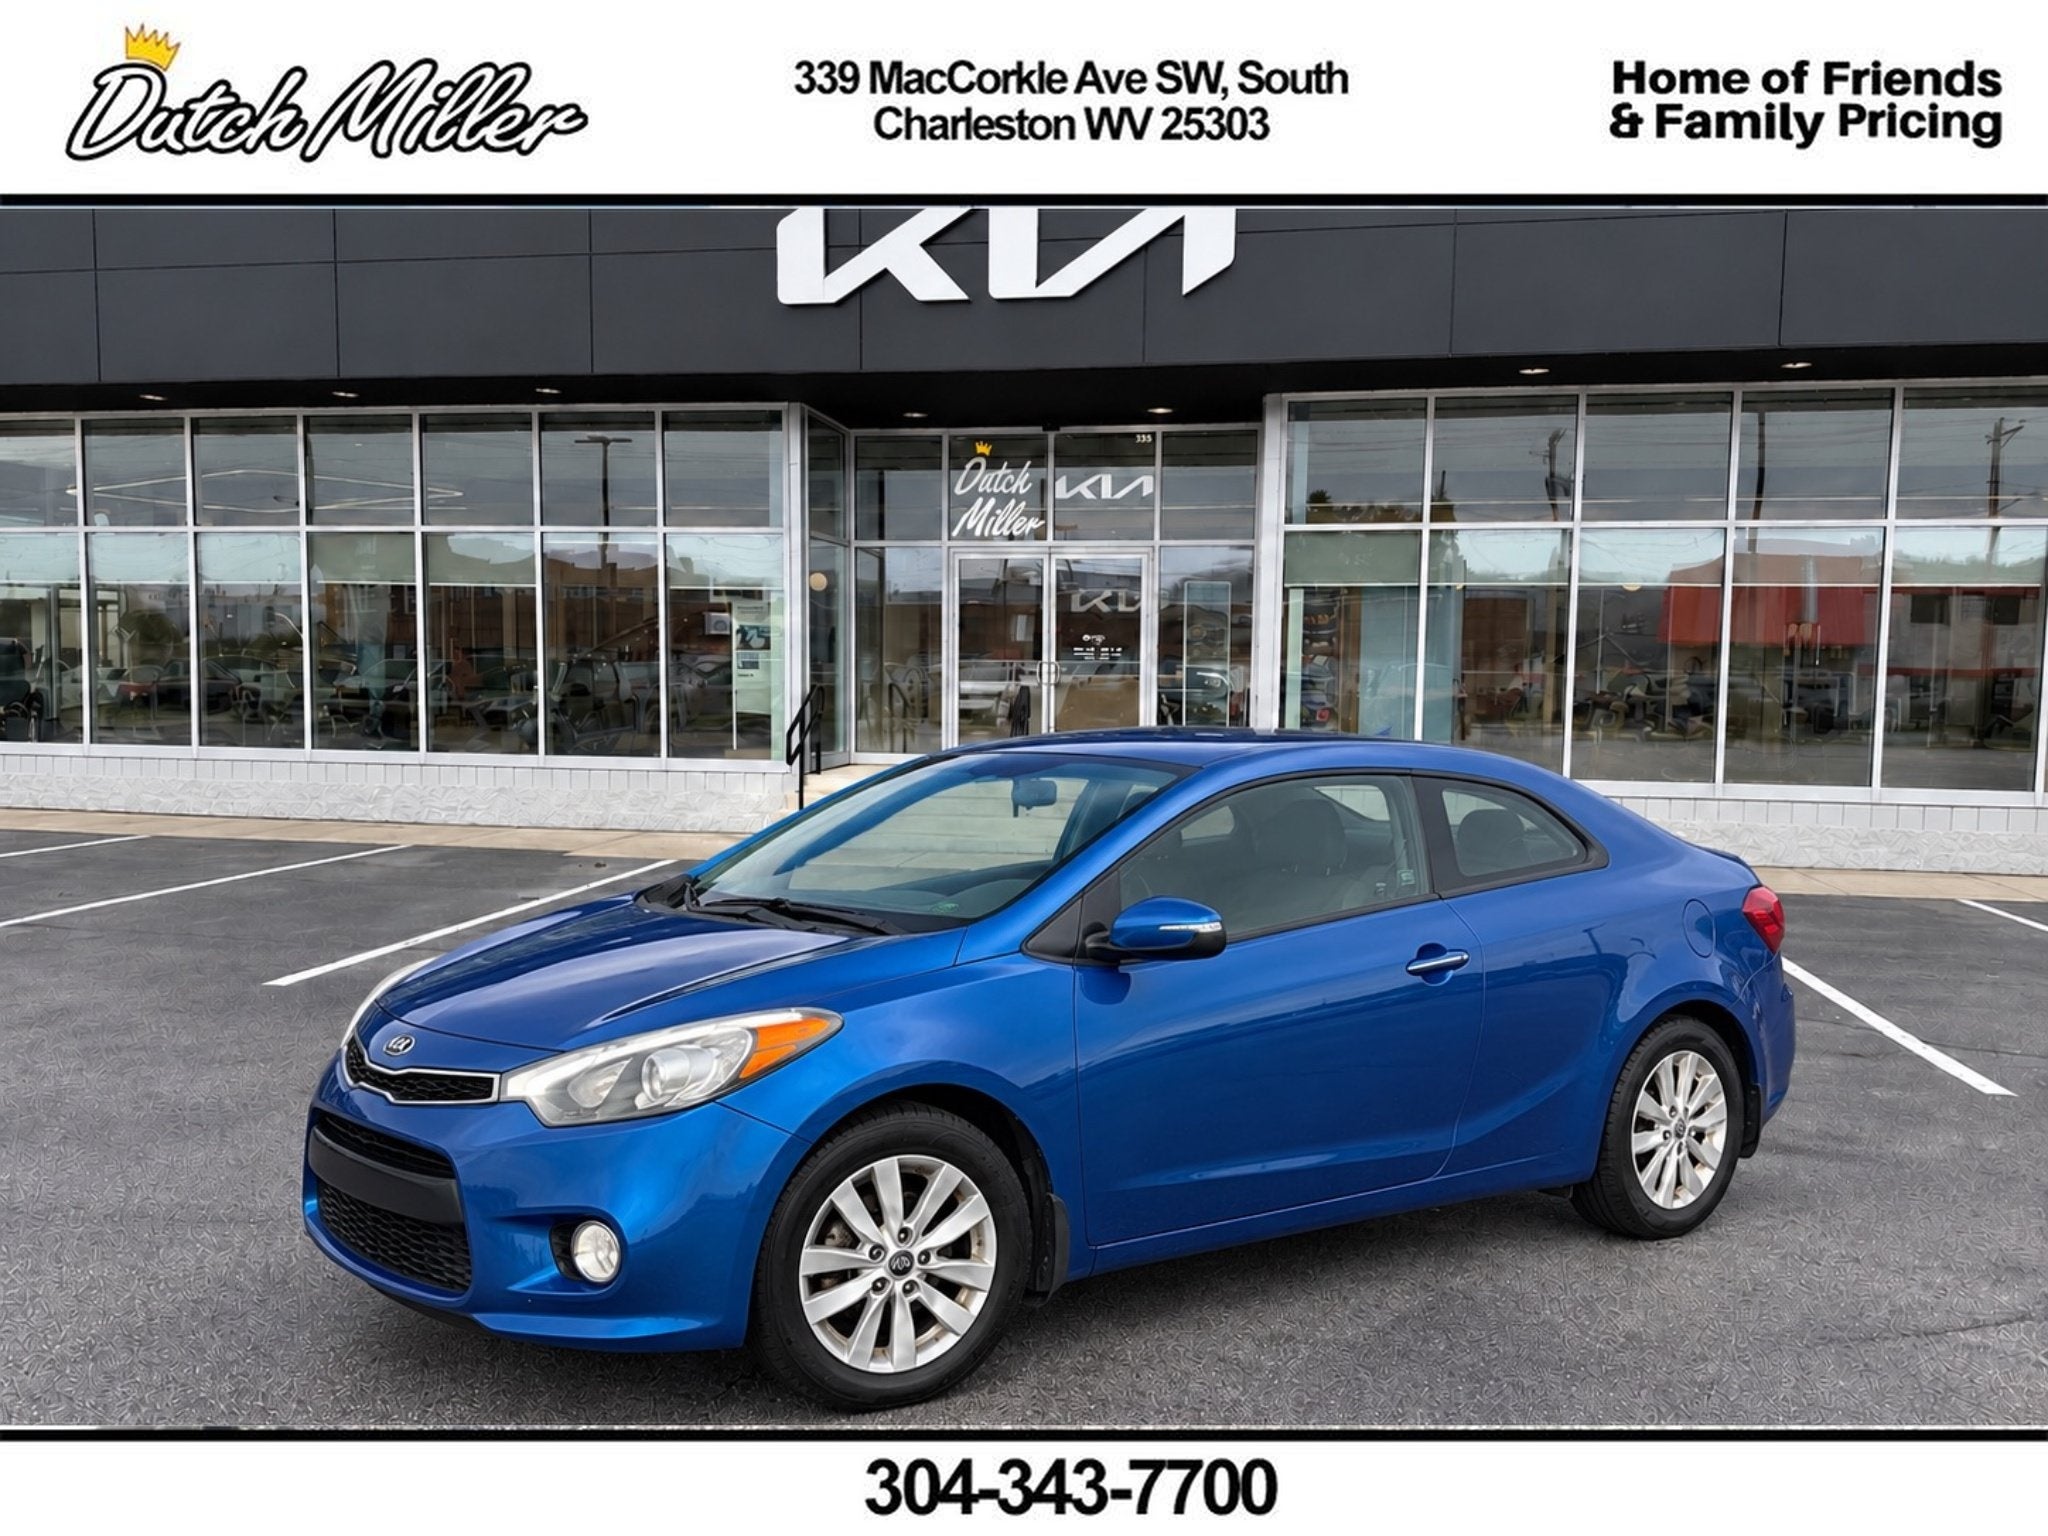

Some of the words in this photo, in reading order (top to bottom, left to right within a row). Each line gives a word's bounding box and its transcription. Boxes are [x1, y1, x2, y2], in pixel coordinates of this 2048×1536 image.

[776, 207, 1237, 304] KIA
[954, 456, 1033, 495] Dutch
[1054, 473, 1154, 500] KIA
[951, 497, 1045, 537] Miller
